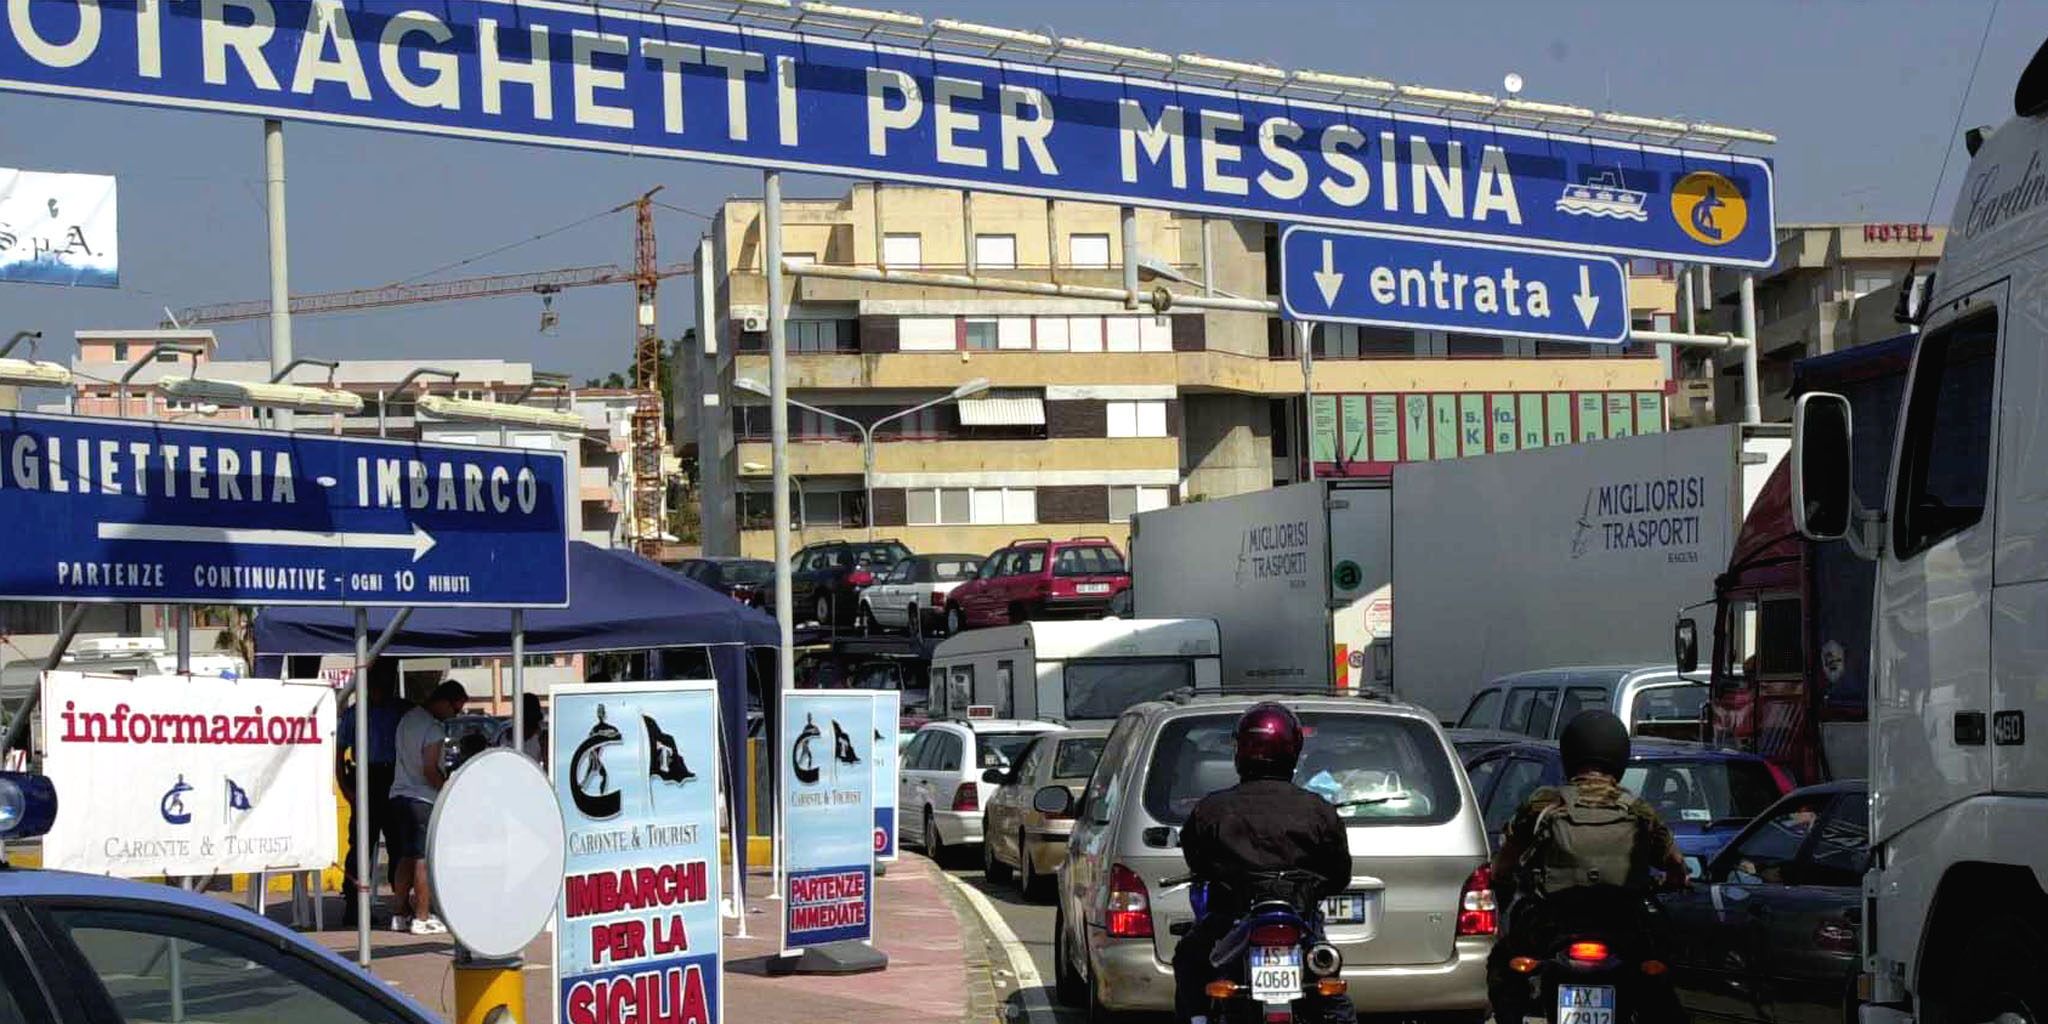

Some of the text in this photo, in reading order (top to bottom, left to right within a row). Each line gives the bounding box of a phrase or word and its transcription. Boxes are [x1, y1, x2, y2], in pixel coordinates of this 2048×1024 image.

[866, 66, 1059, 175] PER
[1119, 98, 1522, 225] MESSINA
[1863, 224, 1934, 242] HOTEL
[1369, 260, 1550, 319] entrata
[0, 434, 296, 505] GLIETTERIA
[358, 456, 537, 514] IMBARCO
[1598, 477, 1704, 516] MIGLIORISI
[1250, 521, 1308, 551] MIGLIORISI
[1602, 516, 1699, 550] TRASPORTI
[58, 561, 165, 587] PARTENZE
[194, 564, 326, 591] CONTINUATIVE
[351, 573, 383, 592] OGNI
[394, 571, 415, 592] 10
[429, 575, 470, 593] MINUTI
[1252, 552, 1306, 579] TRASPORTI
[61, 701, 322, 744] informazioni
[104, 834, 292, 858] CARONTE & TOURIST
[569, 824, 698, 856] CARONTE & TOURIST
[565, 861, 707, 918] IMBARCHI
[791, 873, 864, 902] PARTENZE
[791, 901, 864, 930] IMMEDIATE
[592, 915, 687, 964] PER LA
[1254, 970, 1297, 988] 40681
[569, 967, 707, 1024] SICILIA
[1574, 989, 1592, 1006] AX
